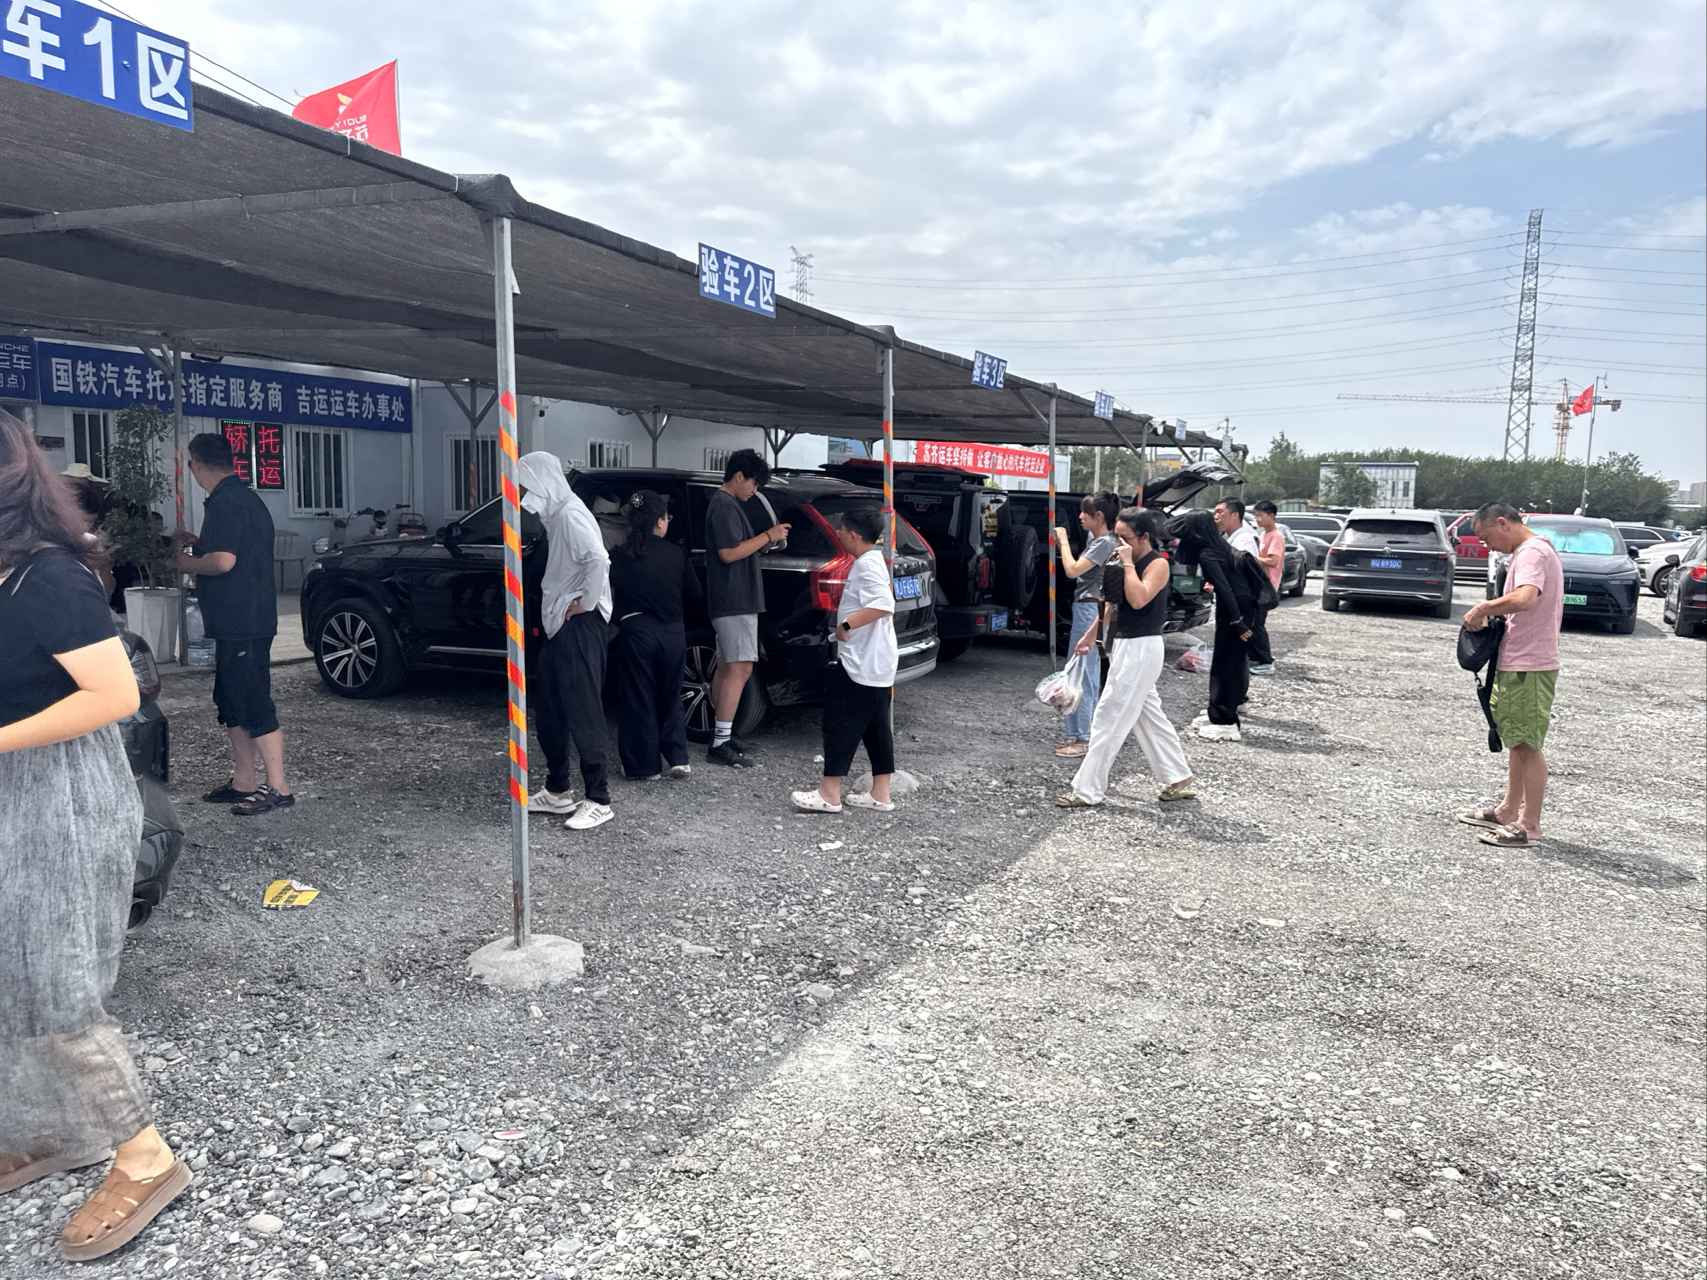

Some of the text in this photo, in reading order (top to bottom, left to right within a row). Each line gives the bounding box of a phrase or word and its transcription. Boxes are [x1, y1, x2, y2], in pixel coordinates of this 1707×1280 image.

[3, 0, 188, 120] 车1区
[701, 246, 775, 312] 验车2区
[972, 352, 1006, 388] 验车3区
[297, 385, 405, 423] 吉运运车办事处
[224, 423, 250, 481] 轿车
[258, 425, 282, 486] 托运
